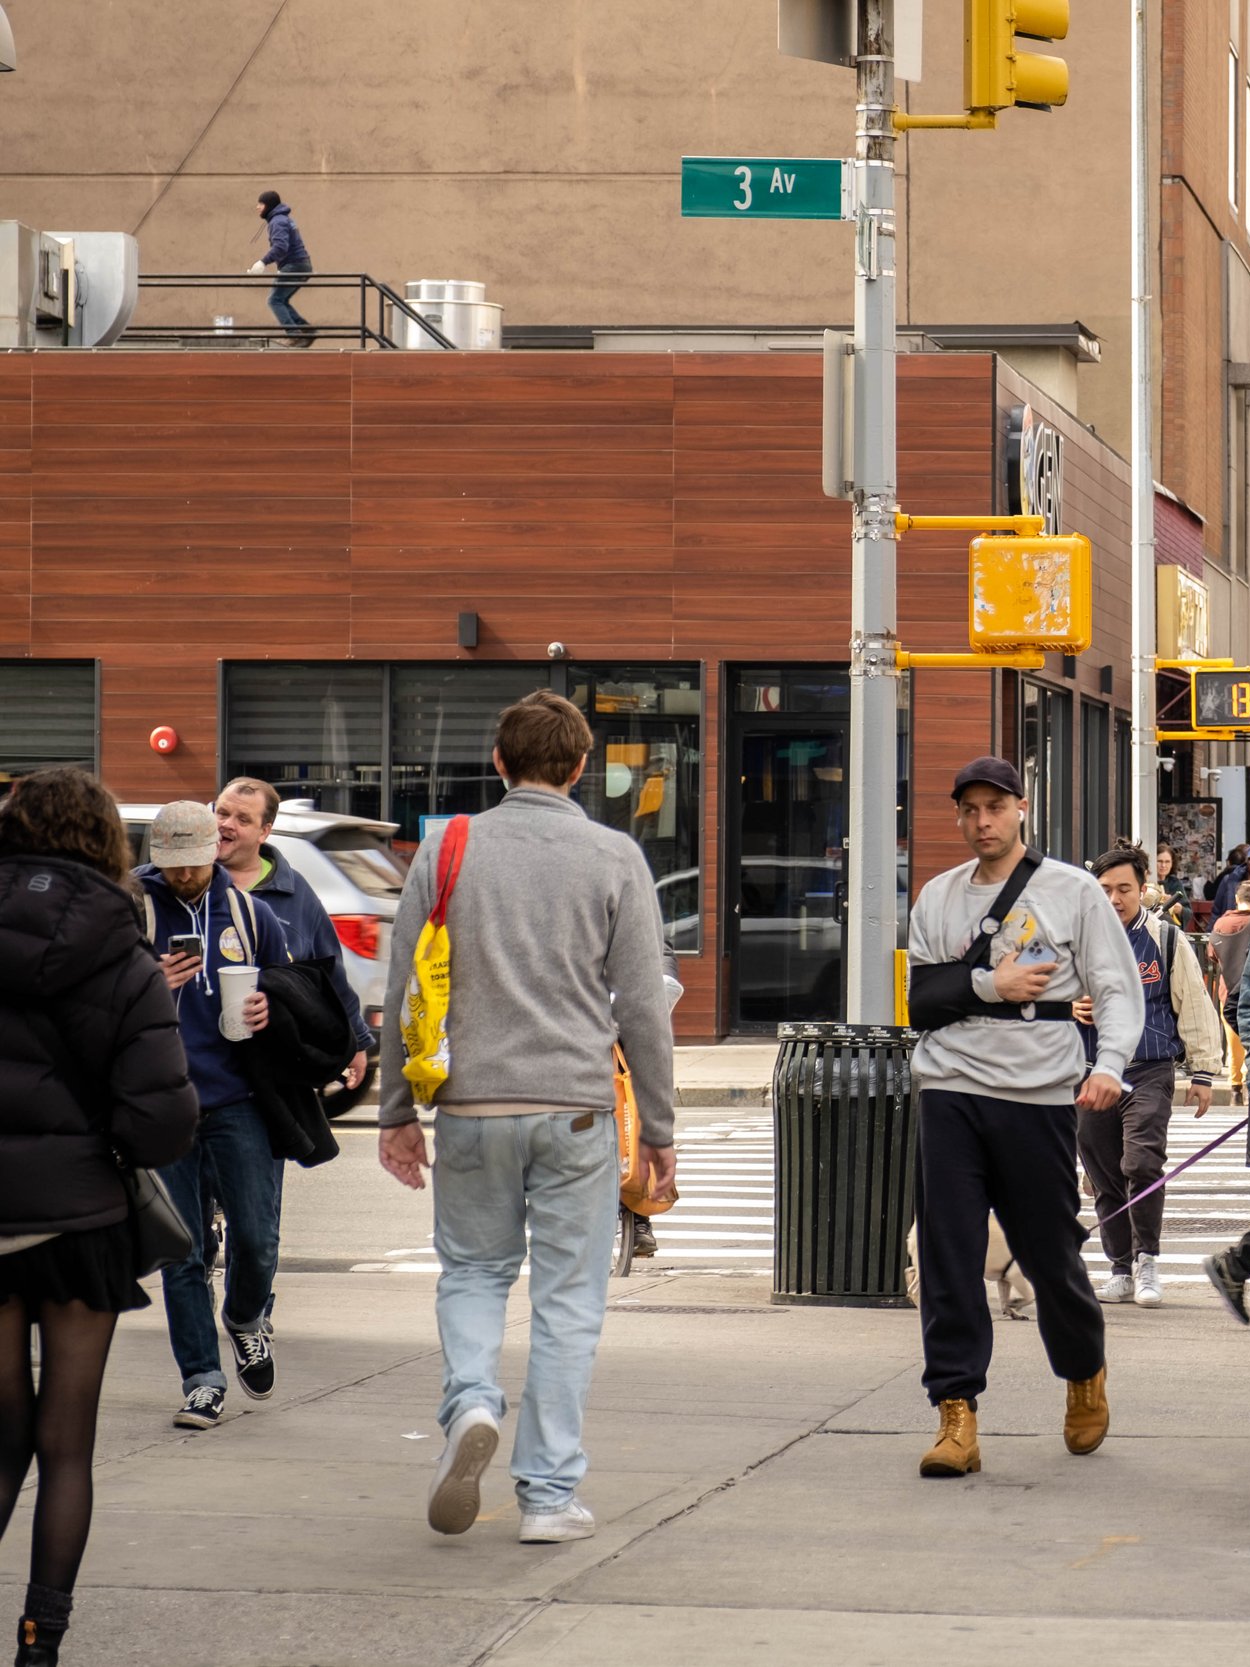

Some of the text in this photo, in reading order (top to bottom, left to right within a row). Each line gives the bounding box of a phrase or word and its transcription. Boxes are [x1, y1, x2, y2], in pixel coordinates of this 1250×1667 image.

[733, 165, 796, 210] 3 Av
[1231, 682, 1250, 718] 13
